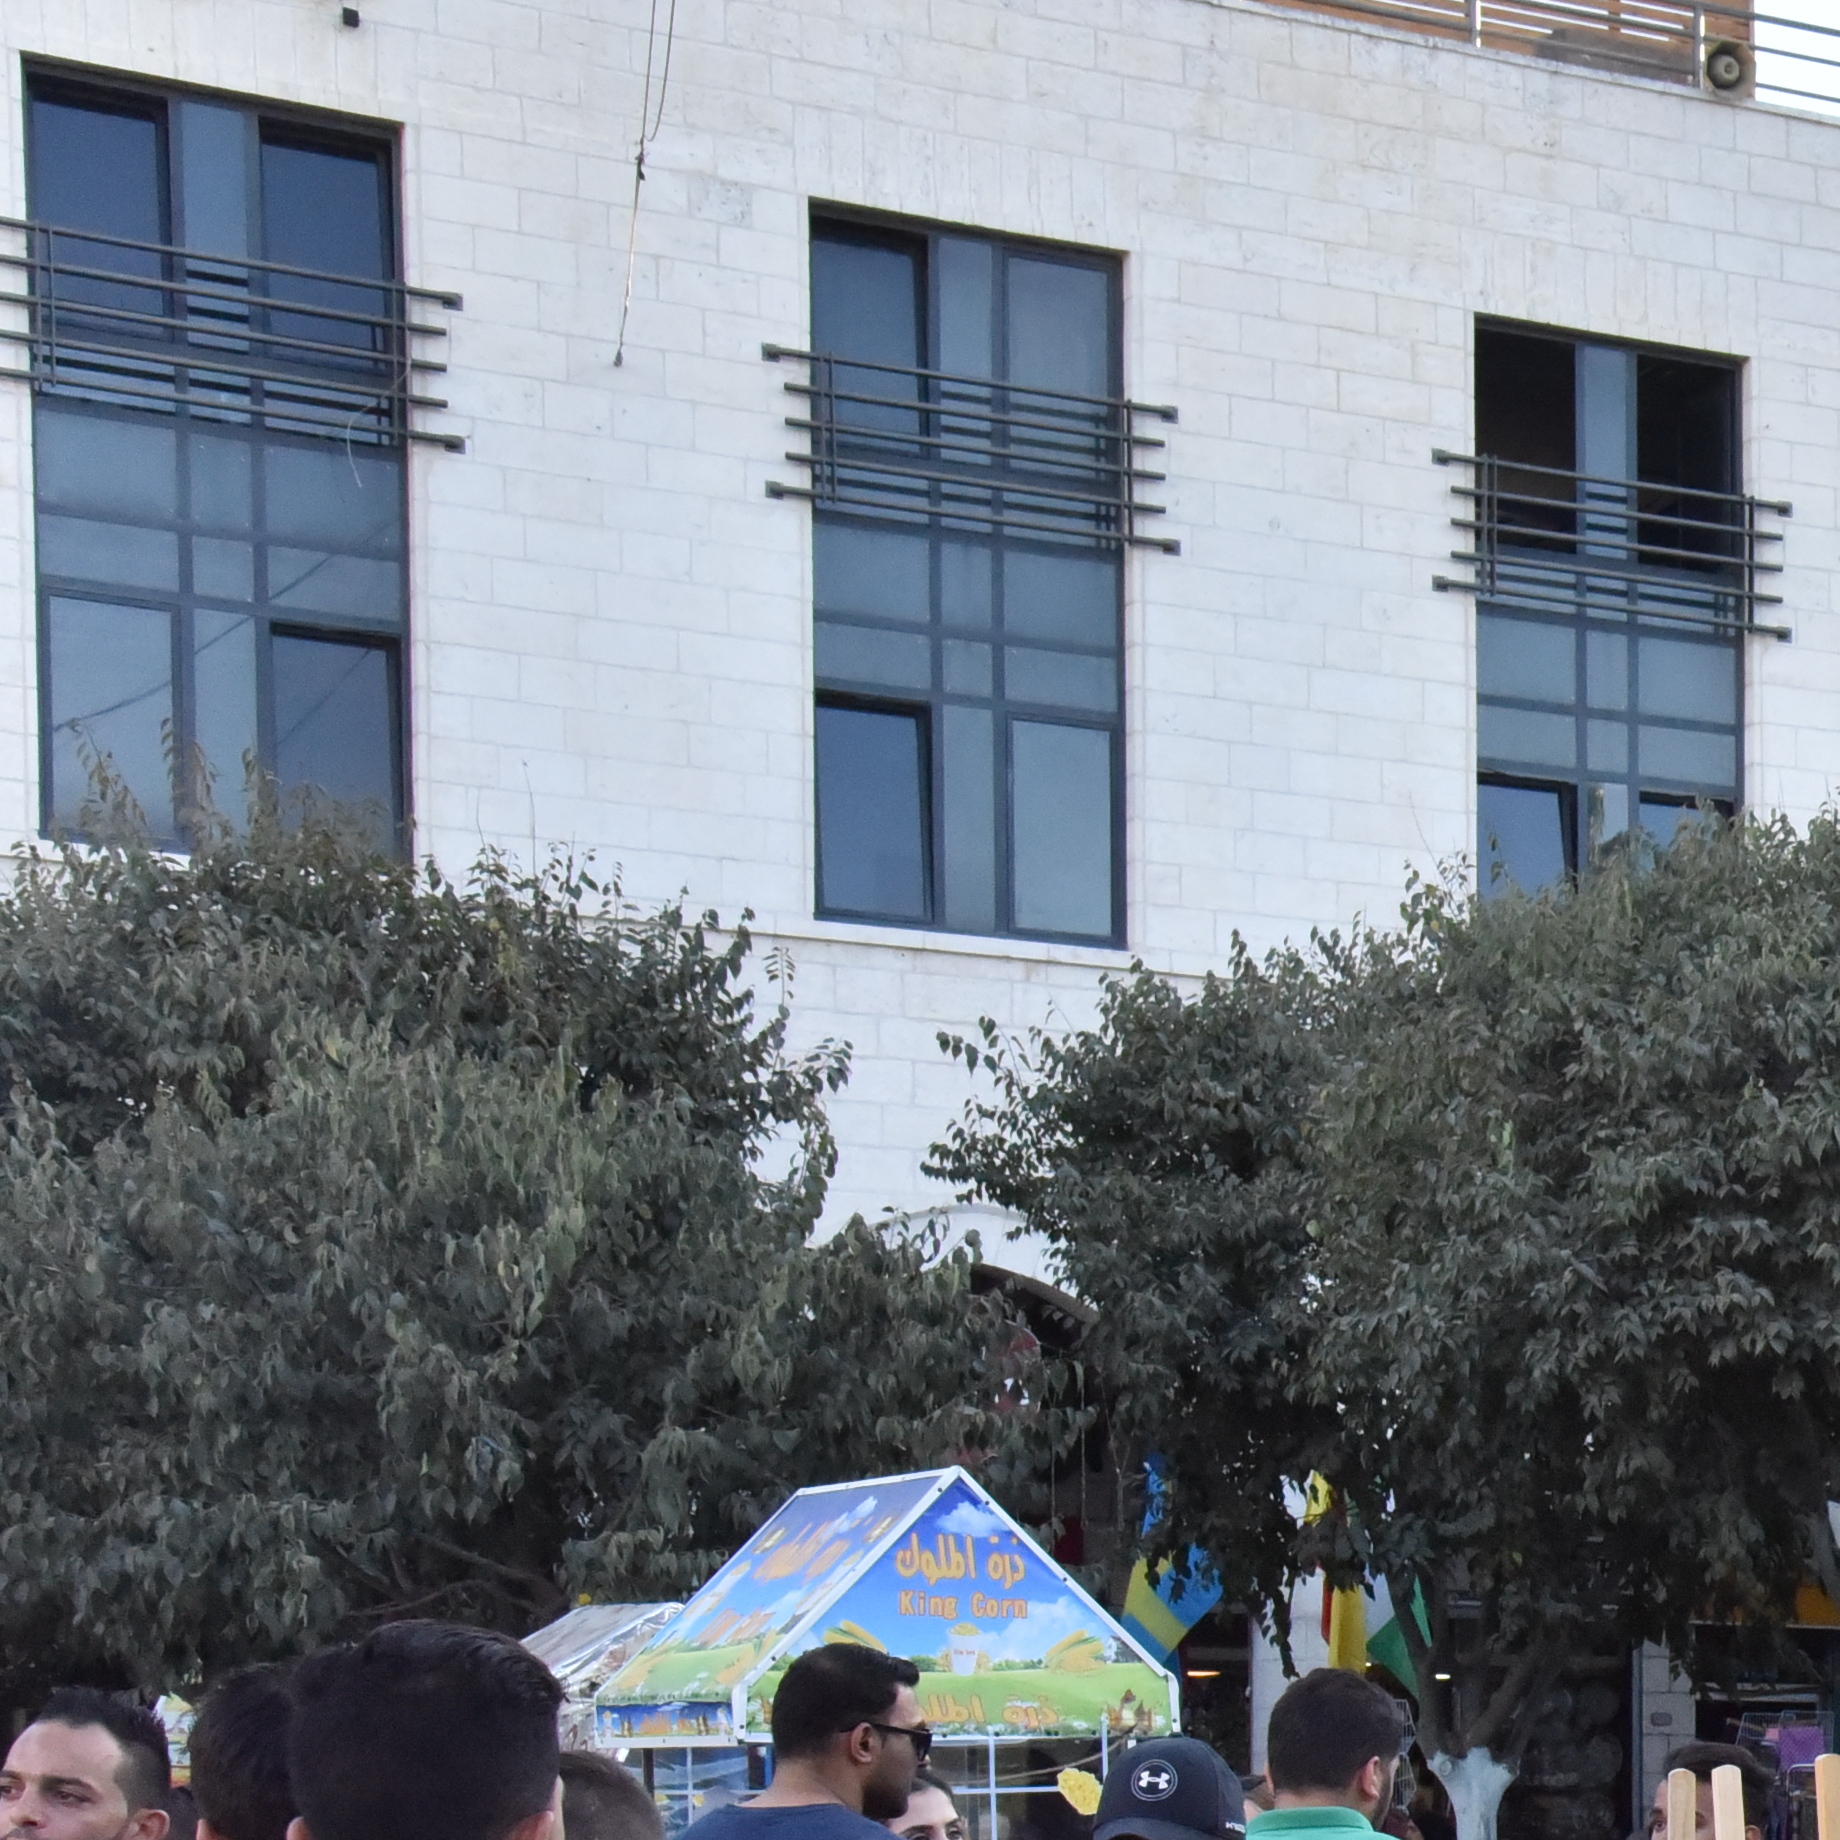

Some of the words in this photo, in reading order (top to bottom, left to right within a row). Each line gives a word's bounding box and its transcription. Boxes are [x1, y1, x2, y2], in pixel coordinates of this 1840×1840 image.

[895, 1532, 977, 1587] الملوك
[987, 1534, 1026, 1590] ذرة
[899, 1589, 958, 1620] King
[971, 1591, 1029, 1619] Corn
